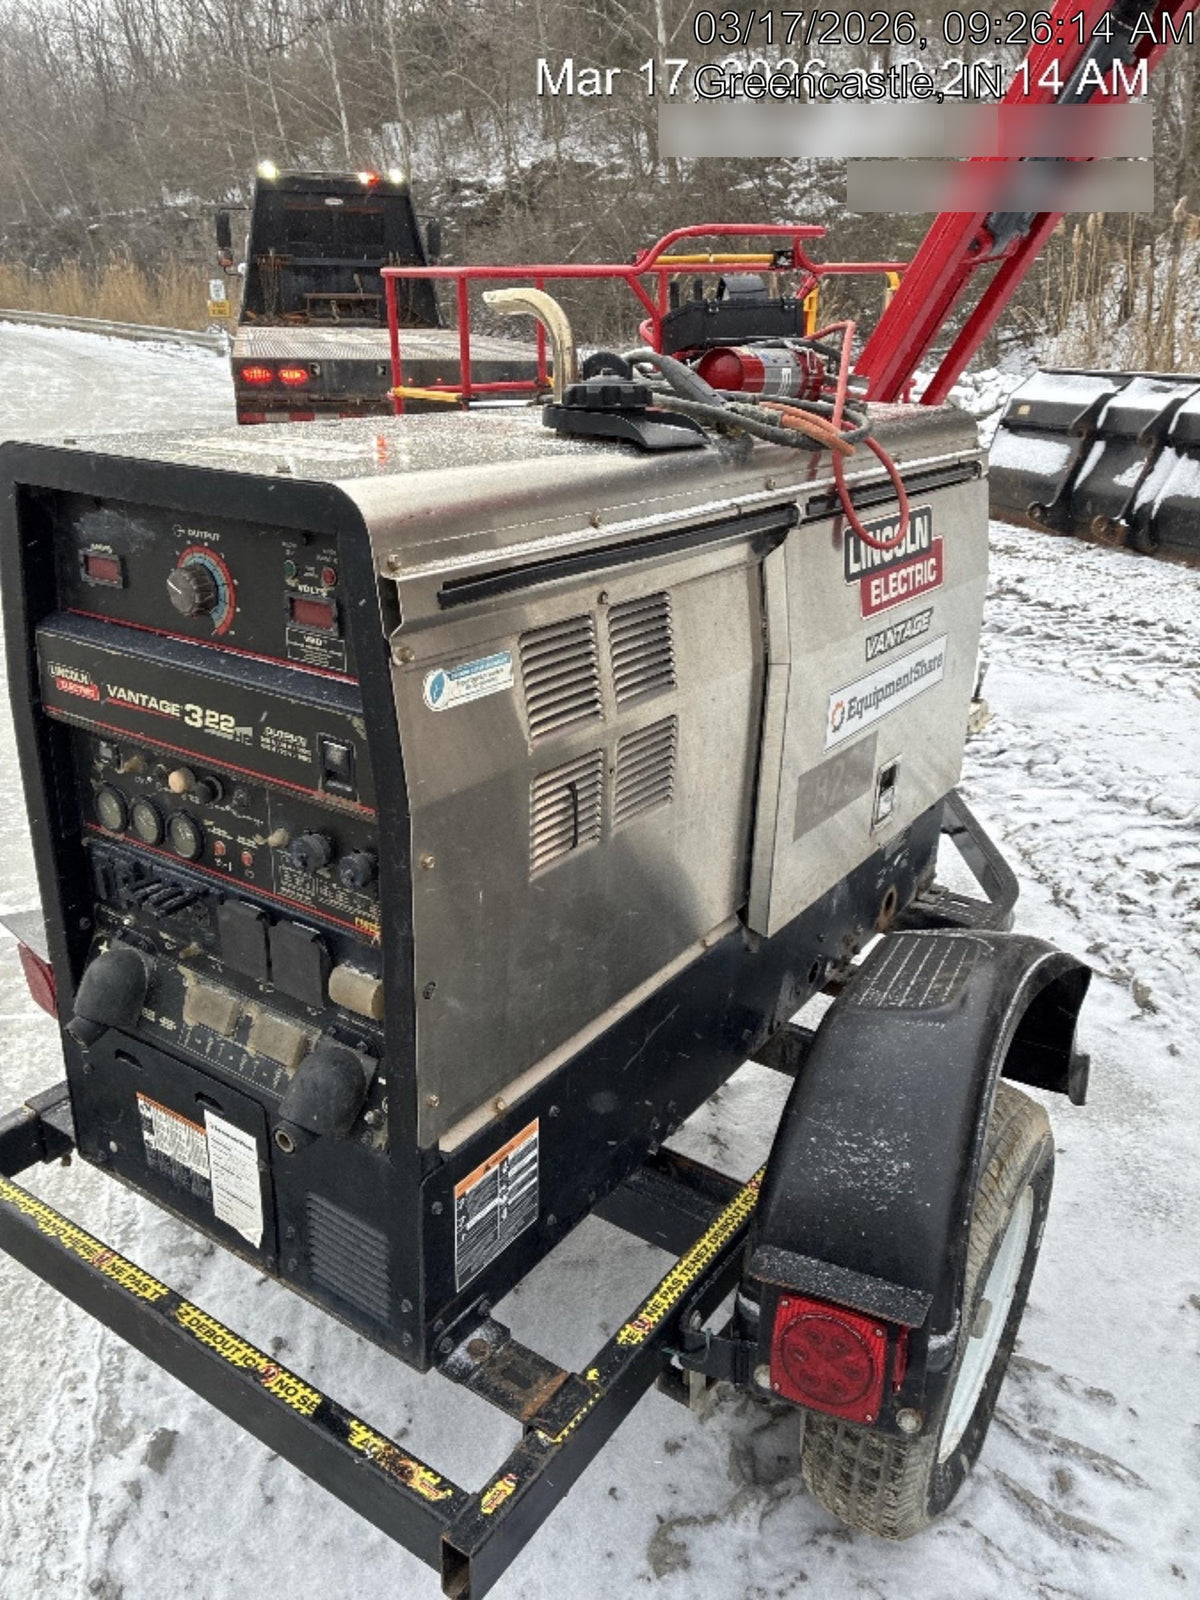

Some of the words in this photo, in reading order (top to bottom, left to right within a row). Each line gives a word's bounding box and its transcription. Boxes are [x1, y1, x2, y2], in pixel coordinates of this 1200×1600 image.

[849, 515, 929, 575] LINCOLN
[870, 557, 937, 607] ELECTRIC
[866, 611, 931, 659] VANTAGE
[106, 684, 180, 717] VANTAGE
[184, 703, 235, 734] 322
[846, 652, 943, 721] EquipmentShare
[34, 1210, 67, 1236] STAND
[65, 1235, 98, 1257] HERE
[107, 1262, 128, 1277] NE
[124, 1274, 152, 1293] PAS
[645, 1300, 663, 1317] NE
[659, 1278, 684, 1299] PAS
[680, 1243, 711, 1278] TENEZ
[707, 1205, 746, 1245] DEBOUT
[188, 1316, 242, 1356] DEBOUT
[239, 1352, 261, 1369] ICI
[275, 1378, 299, 1397] NO
